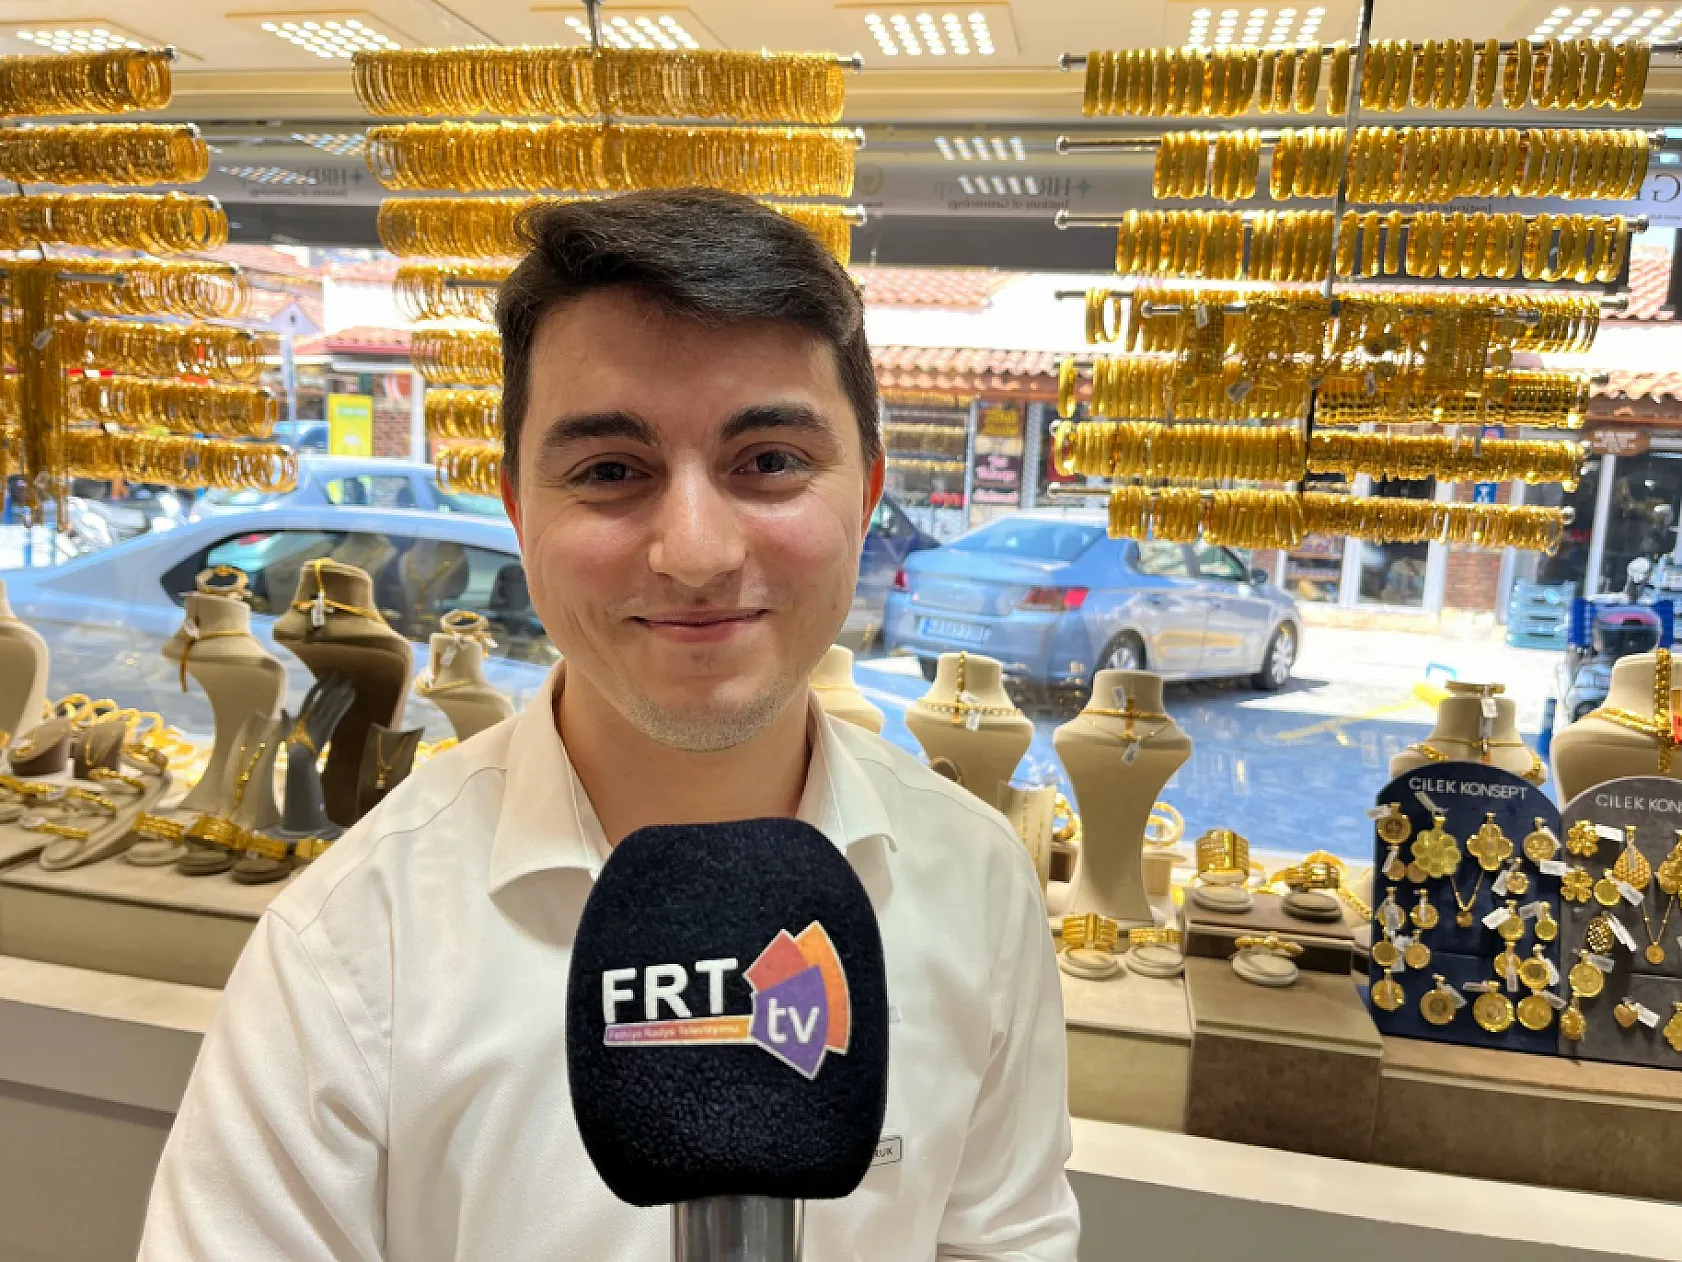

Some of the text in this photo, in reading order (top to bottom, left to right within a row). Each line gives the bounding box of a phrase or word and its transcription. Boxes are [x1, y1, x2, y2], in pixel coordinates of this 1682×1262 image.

[1460, 781, 1529, 800] KONSEPT
[602, 957, 820, 1044] FRT tv
